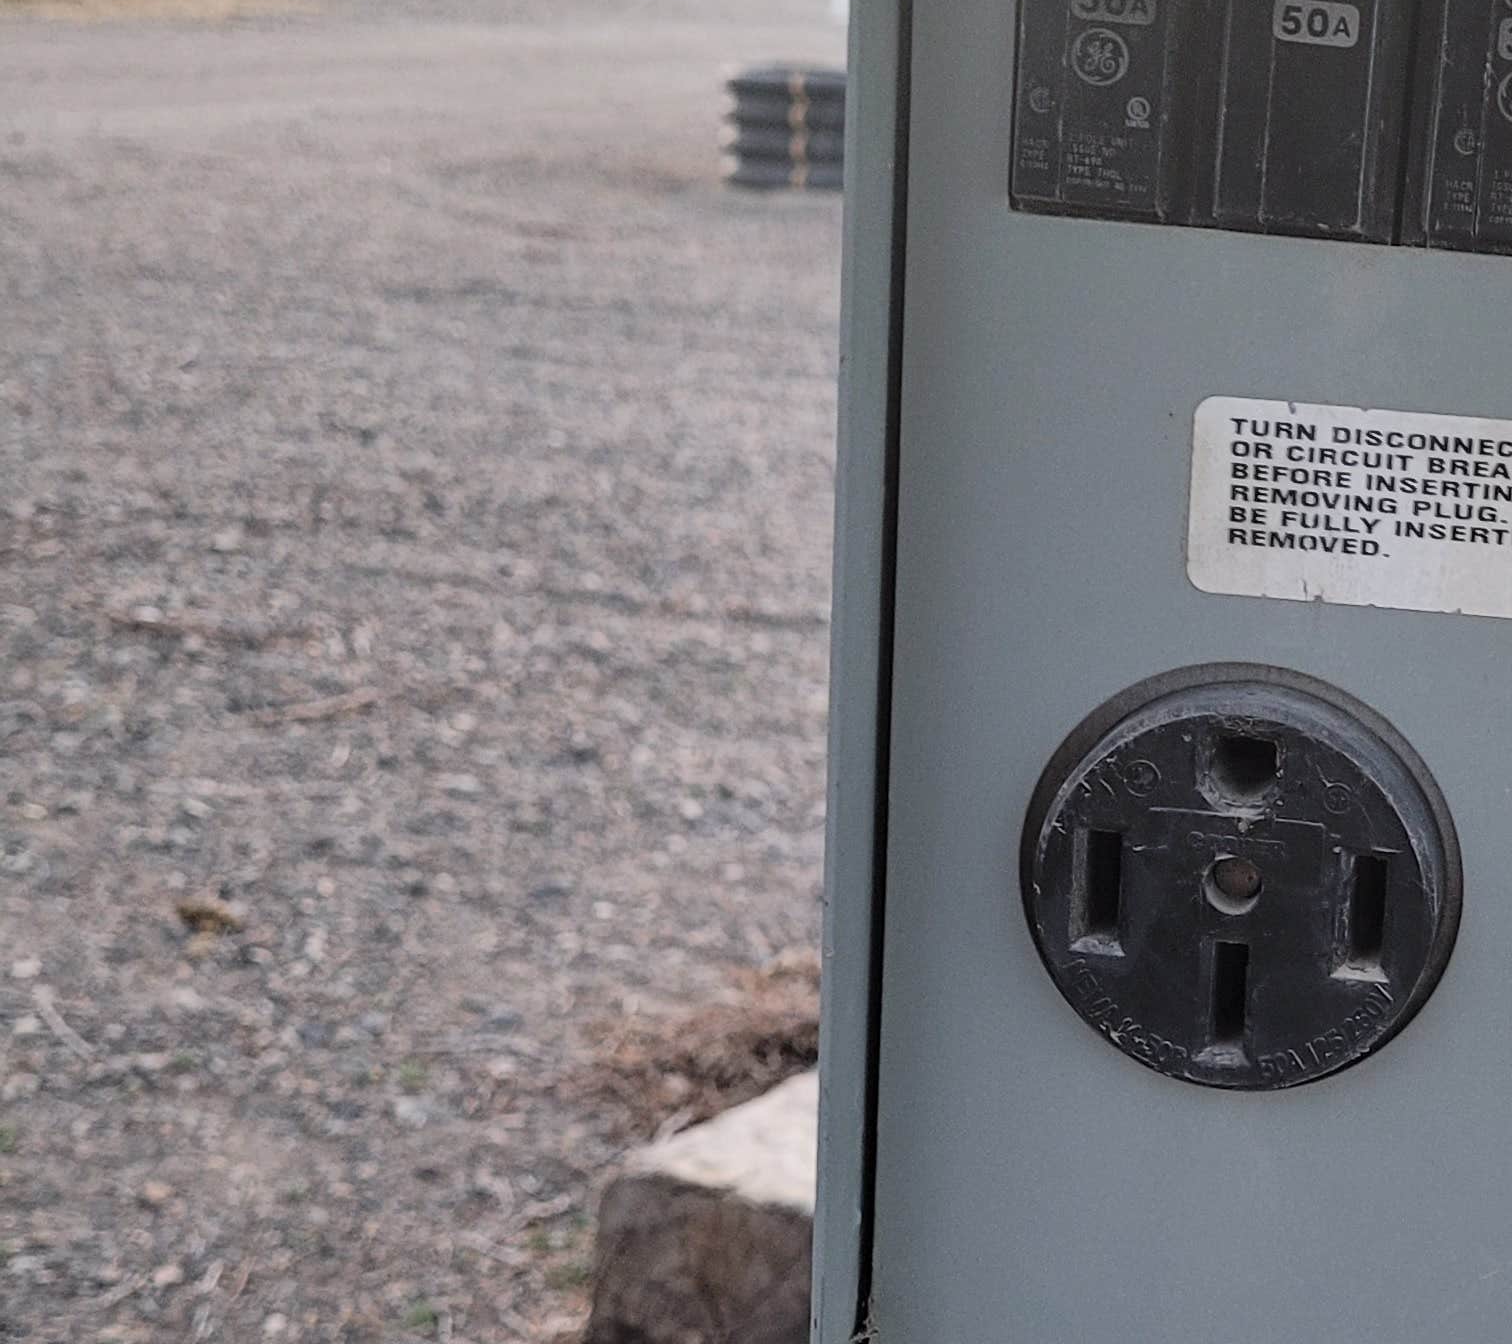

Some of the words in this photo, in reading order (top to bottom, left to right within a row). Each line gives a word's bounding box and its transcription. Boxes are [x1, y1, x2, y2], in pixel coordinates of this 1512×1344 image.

[1281, 5, 1352, 38] 50A
[1230, 418, 1316, 441] TURN
[1231, 441, 1272, 459] OR
[1287, 446, 1413, 471] CIRCUIT
[1231, 463, 1351, 488] BEFORE
[1230, 485, 1397, 514] REMOVING
[1413, 501, 1508, 523] PLUG.
[1229, 506, 1266, 525] BE
[1282, 511, 1381, 534] FULLY
[1228, 528, 1390, 557] REMOVED.
